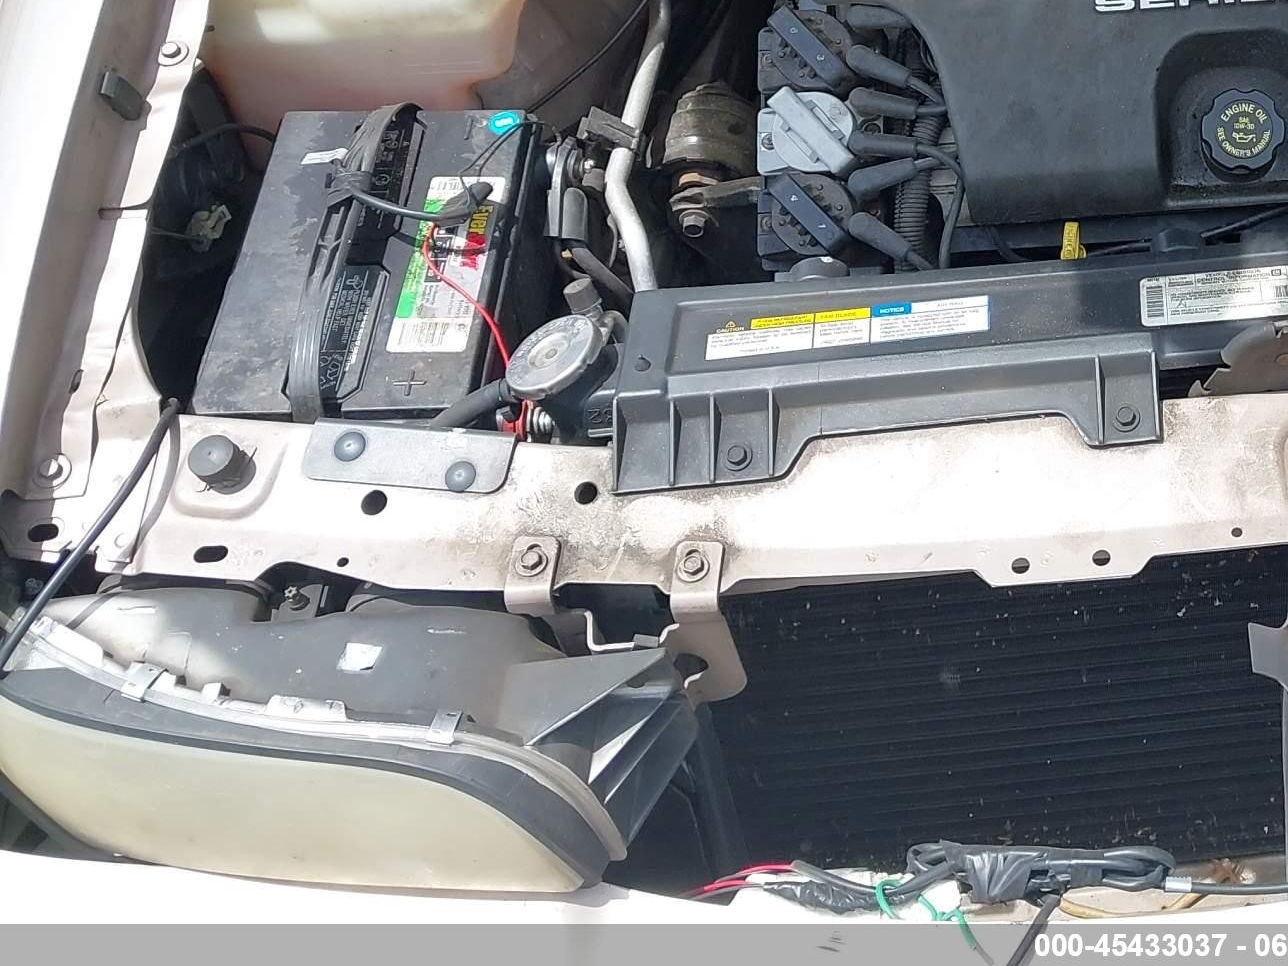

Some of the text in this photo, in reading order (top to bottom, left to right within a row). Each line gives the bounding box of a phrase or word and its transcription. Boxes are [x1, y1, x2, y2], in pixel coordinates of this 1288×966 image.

[1221, 103, 1268, 124] ENGINE OIL
[1217, 127, 1271, 156] SEE OWNER'S MANUAL
[879, 306, 905, 314] NOTICE
[716, 326, 745, 334] CAUTION
